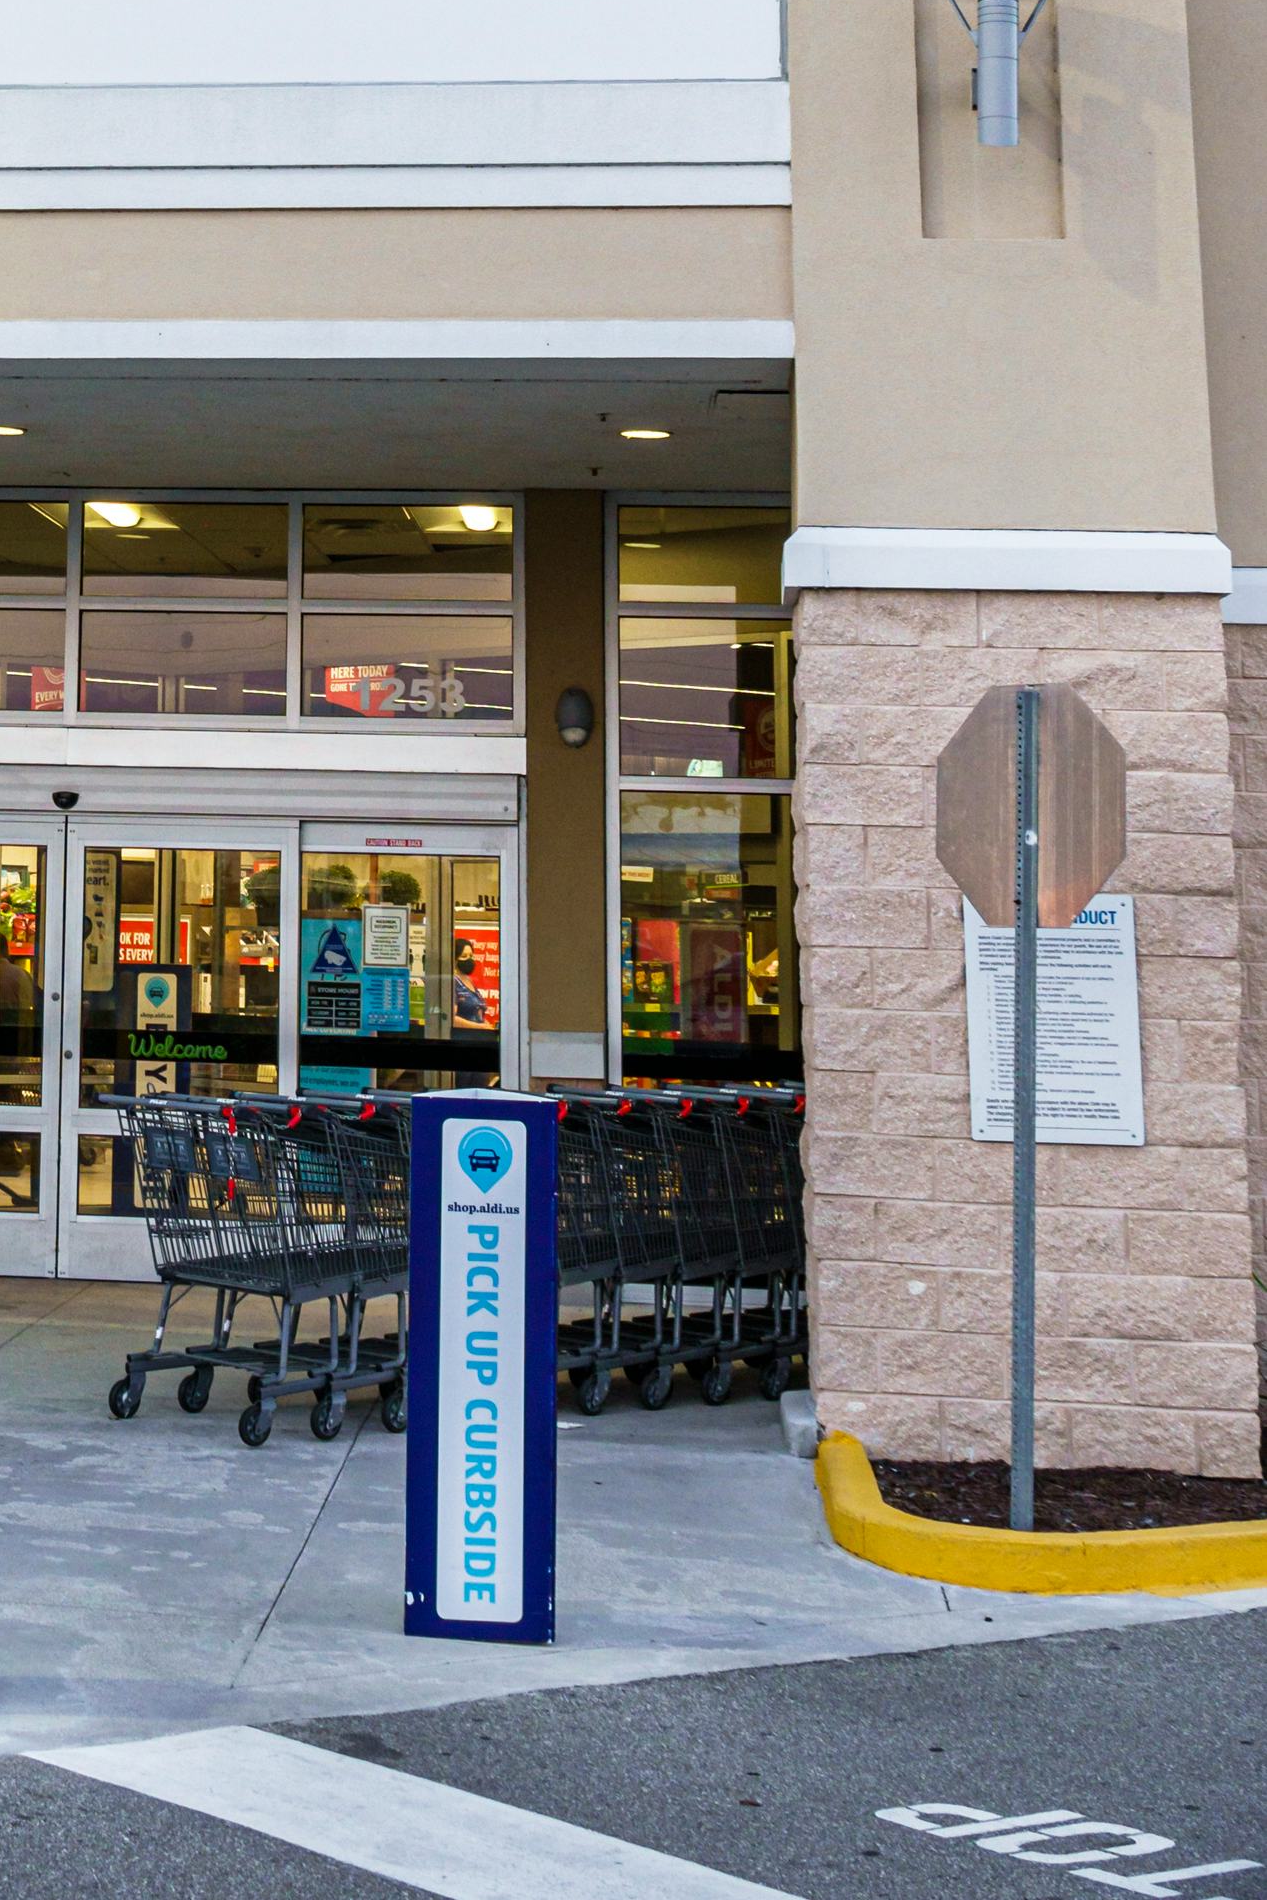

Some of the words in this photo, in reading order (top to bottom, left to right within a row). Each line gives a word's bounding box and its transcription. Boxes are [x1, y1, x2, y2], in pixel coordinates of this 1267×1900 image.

[330, 666, 355, 679] HERE
[357, 665, 389, 678] TODAY
[330, 682, 348, 692] GONE
[352, 676, 466, 712] 1253
[749, 758, 775, 769] LIMITE
[86, 876, 110, 886] eart.
[714, 873, 739, 884] CEREAL
[1072, 909, 1117, 925] DUCT
[133, 933, 151, 946] FOR
[125, 948, 154, 962] EVERY
[713, 944, 733, 1032] ALDI
[127, 1033, 228, 1060] Welcome
[447, 1201, 520, 1216] shop.aldi.us
[466, 1224, 499, 1317] PICK
[465, 1331, 498, 1386] UP
[463, 1398, 497, 1604] CURBSIDE
[875, 1803, 1265, 1900] TOP
